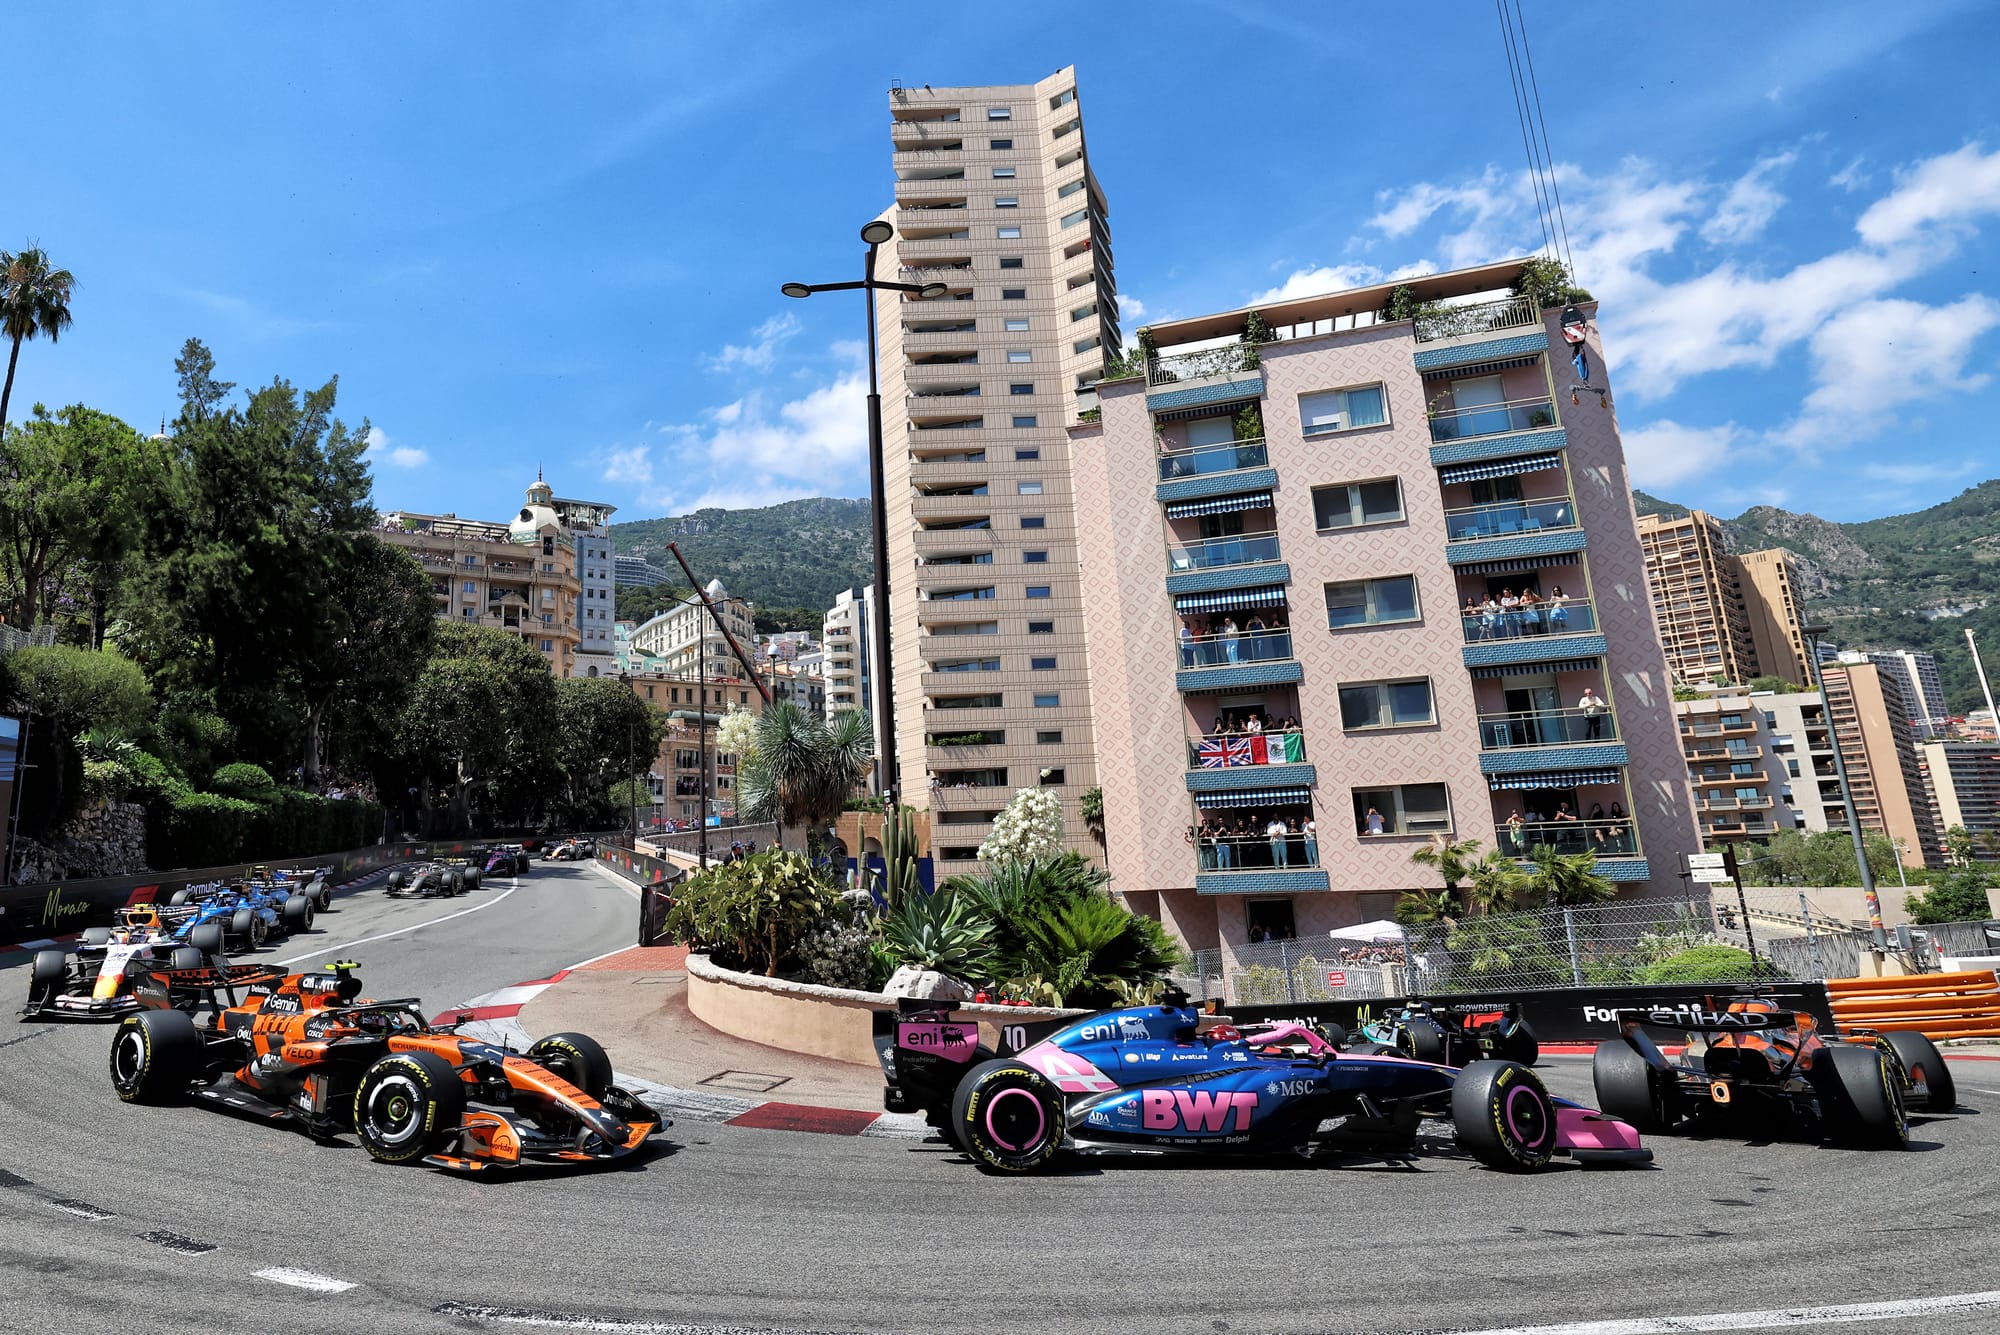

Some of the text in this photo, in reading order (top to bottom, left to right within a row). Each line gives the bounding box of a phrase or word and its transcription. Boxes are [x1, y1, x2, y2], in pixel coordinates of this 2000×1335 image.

[43, 887, 90, 928] Monaco
[270, 994, 299, 1012] Gemini
[1454, 1003, 1510, 1012] CROWDSTRIKE
[1649, 1011, 1769, 1026] ETIHAD
[907, 1027, 938, 1046] eni
[1080, 1019, 1117, 1041] eni
[391, 1042, 417, 1051] RICHARD
[1004, 1026, 1027, 1053] 10
[286, 1046, 314, 1059] VELO
[1280, 1079, 1314, 1096] MSC
[1088, 1110, 1110, 1123] ADA
[1142, 1089, 1259, 1132] BWT
[1226, 1134, 1250, 1144] Delphi
[490, 1142, 513, 1154] workday
